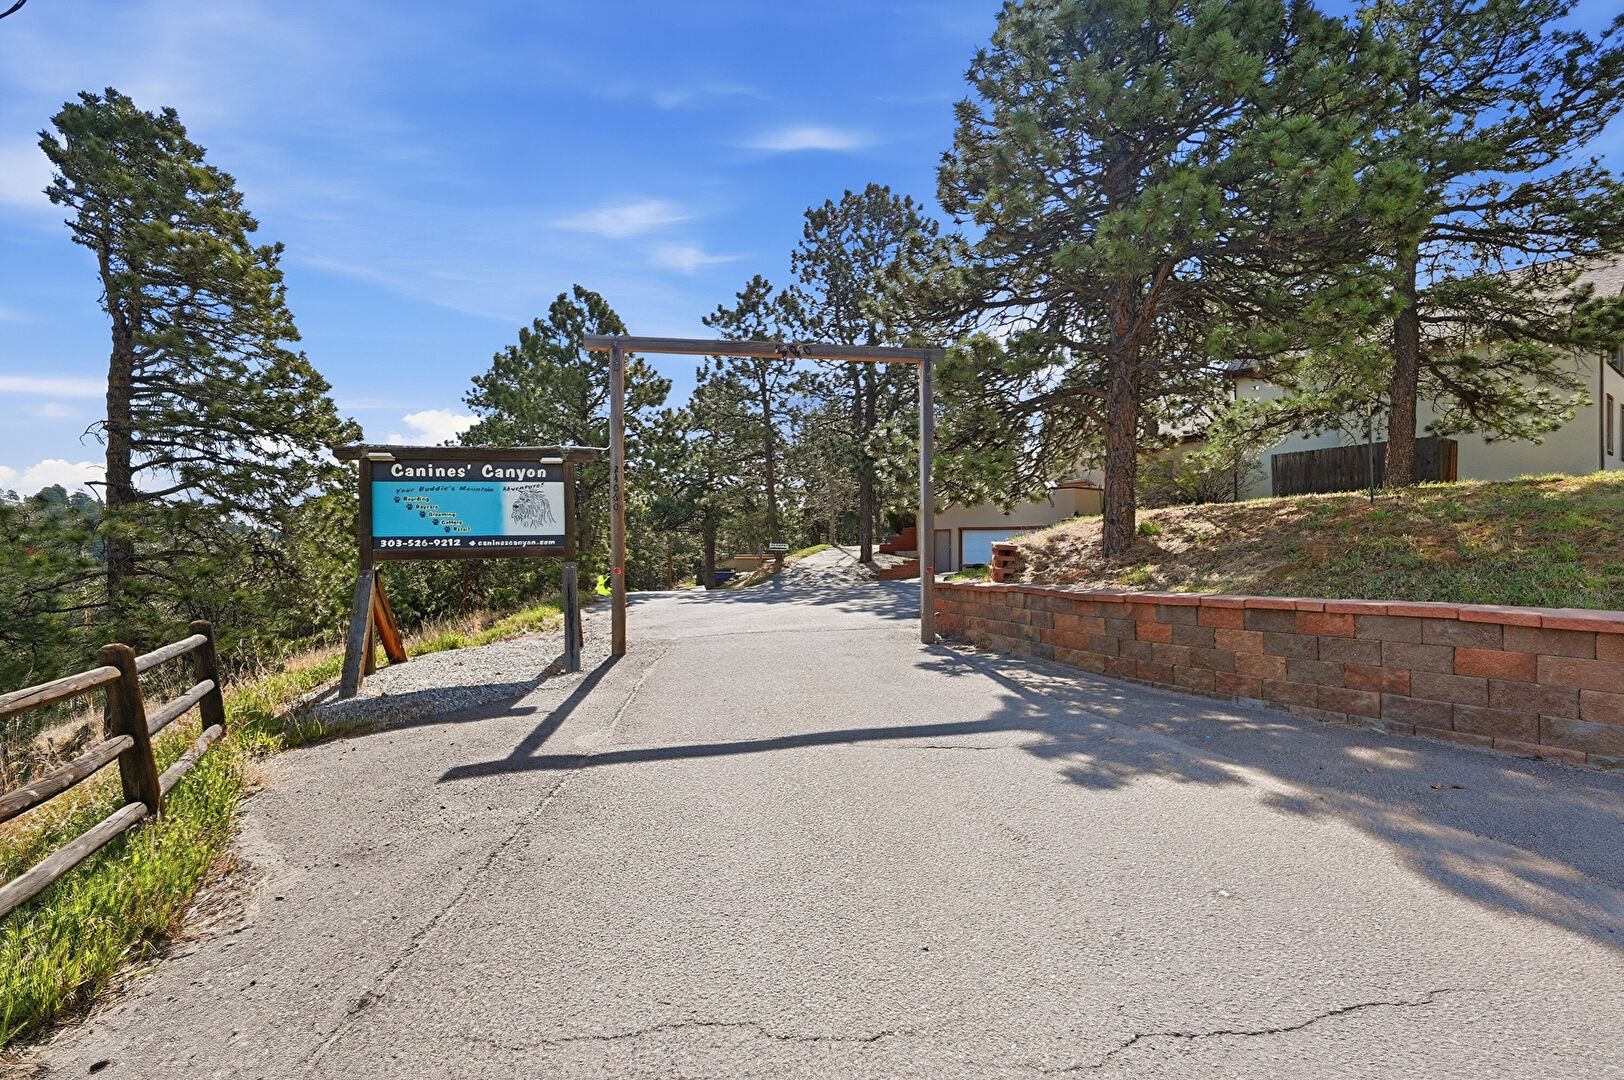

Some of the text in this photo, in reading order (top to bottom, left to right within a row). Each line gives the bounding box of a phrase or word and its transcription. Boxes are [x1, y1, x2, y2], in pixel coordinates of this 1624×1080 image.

[390, 463, 547, 481] Canines' Canyon
[380, 539, 556, 548] 303-526-9212 caninescanyon.com
